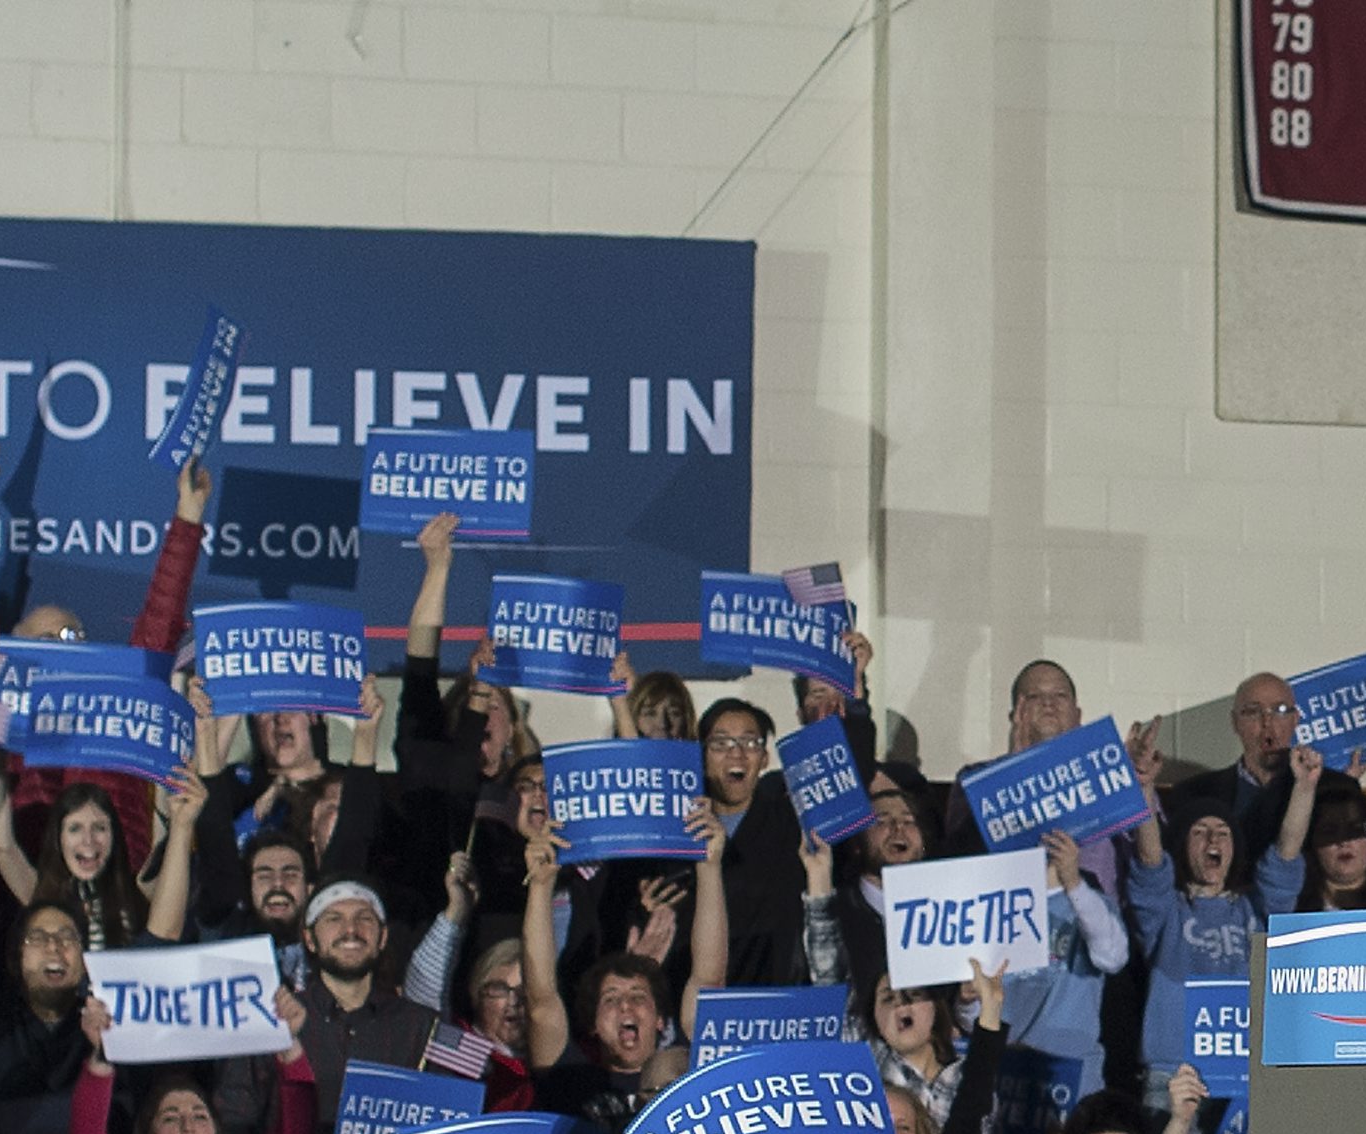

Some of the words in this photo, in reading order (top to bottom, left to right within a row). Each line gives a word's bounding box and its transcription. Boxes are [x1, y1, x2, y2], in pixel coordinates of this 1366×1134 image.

[1272, 13, 1313, 53] 79
[1271, 61, 1313, 101] 80
[1270, 108, 1311, 148] 88
[628, 378, 734, 455] IN
[372, 451, 389, 471] A
[395, 452, 489, 476] FUTURE
[494, 456, 527, 478] TO
[370, 474, 488, 501] BELIEVE
[495, 478, 527, 503] IN
[513, 602, 596, 628] FUTURE
[599, 610, 618, 630] TO
[710, 592, 726, 612] A
[732, 594, 826, 627] FUTURE
[204, 630, 222, 653] A
[227, 628, 324, 650] FUTURE
[329, 632, 361, 656] TO
[493, 624, 594, 657] BELIEVE
[596, 635, 616, 658] IN
[709, 613, 826, 649] BELIEVE
[204, 653, 327, 679] BELIEVE
[334, 656, 363, 681] IN
[37, 689, 56, 713] A
[62, 692, 163, 724] FUTURE
[35, 714, 164, 748] BELIEVE
[569, 768, 662, 792] FUTURE
[668, 769, 697, 792] TO
[981, 795, 998, 815] A
[995, 762, 1086, 812] FUTURE
[1087, 743, 1122, 772] TO
[553, 793, 666, 822] BELIEVE
[986, 782, 1096, 843] BELIEVE
[1099, 764, 1133, 794] IN
[893, 887, 1042, 950] TOGETHER
[101, 973, 279, 1029] TOGETHER
[358, 1098, 434, 1125] FUTURE
[667, 1075, 814, 1132] FUTURE
[819, 1072, 873, 1096] TO
[835, 1100, 885, 1129] IN
